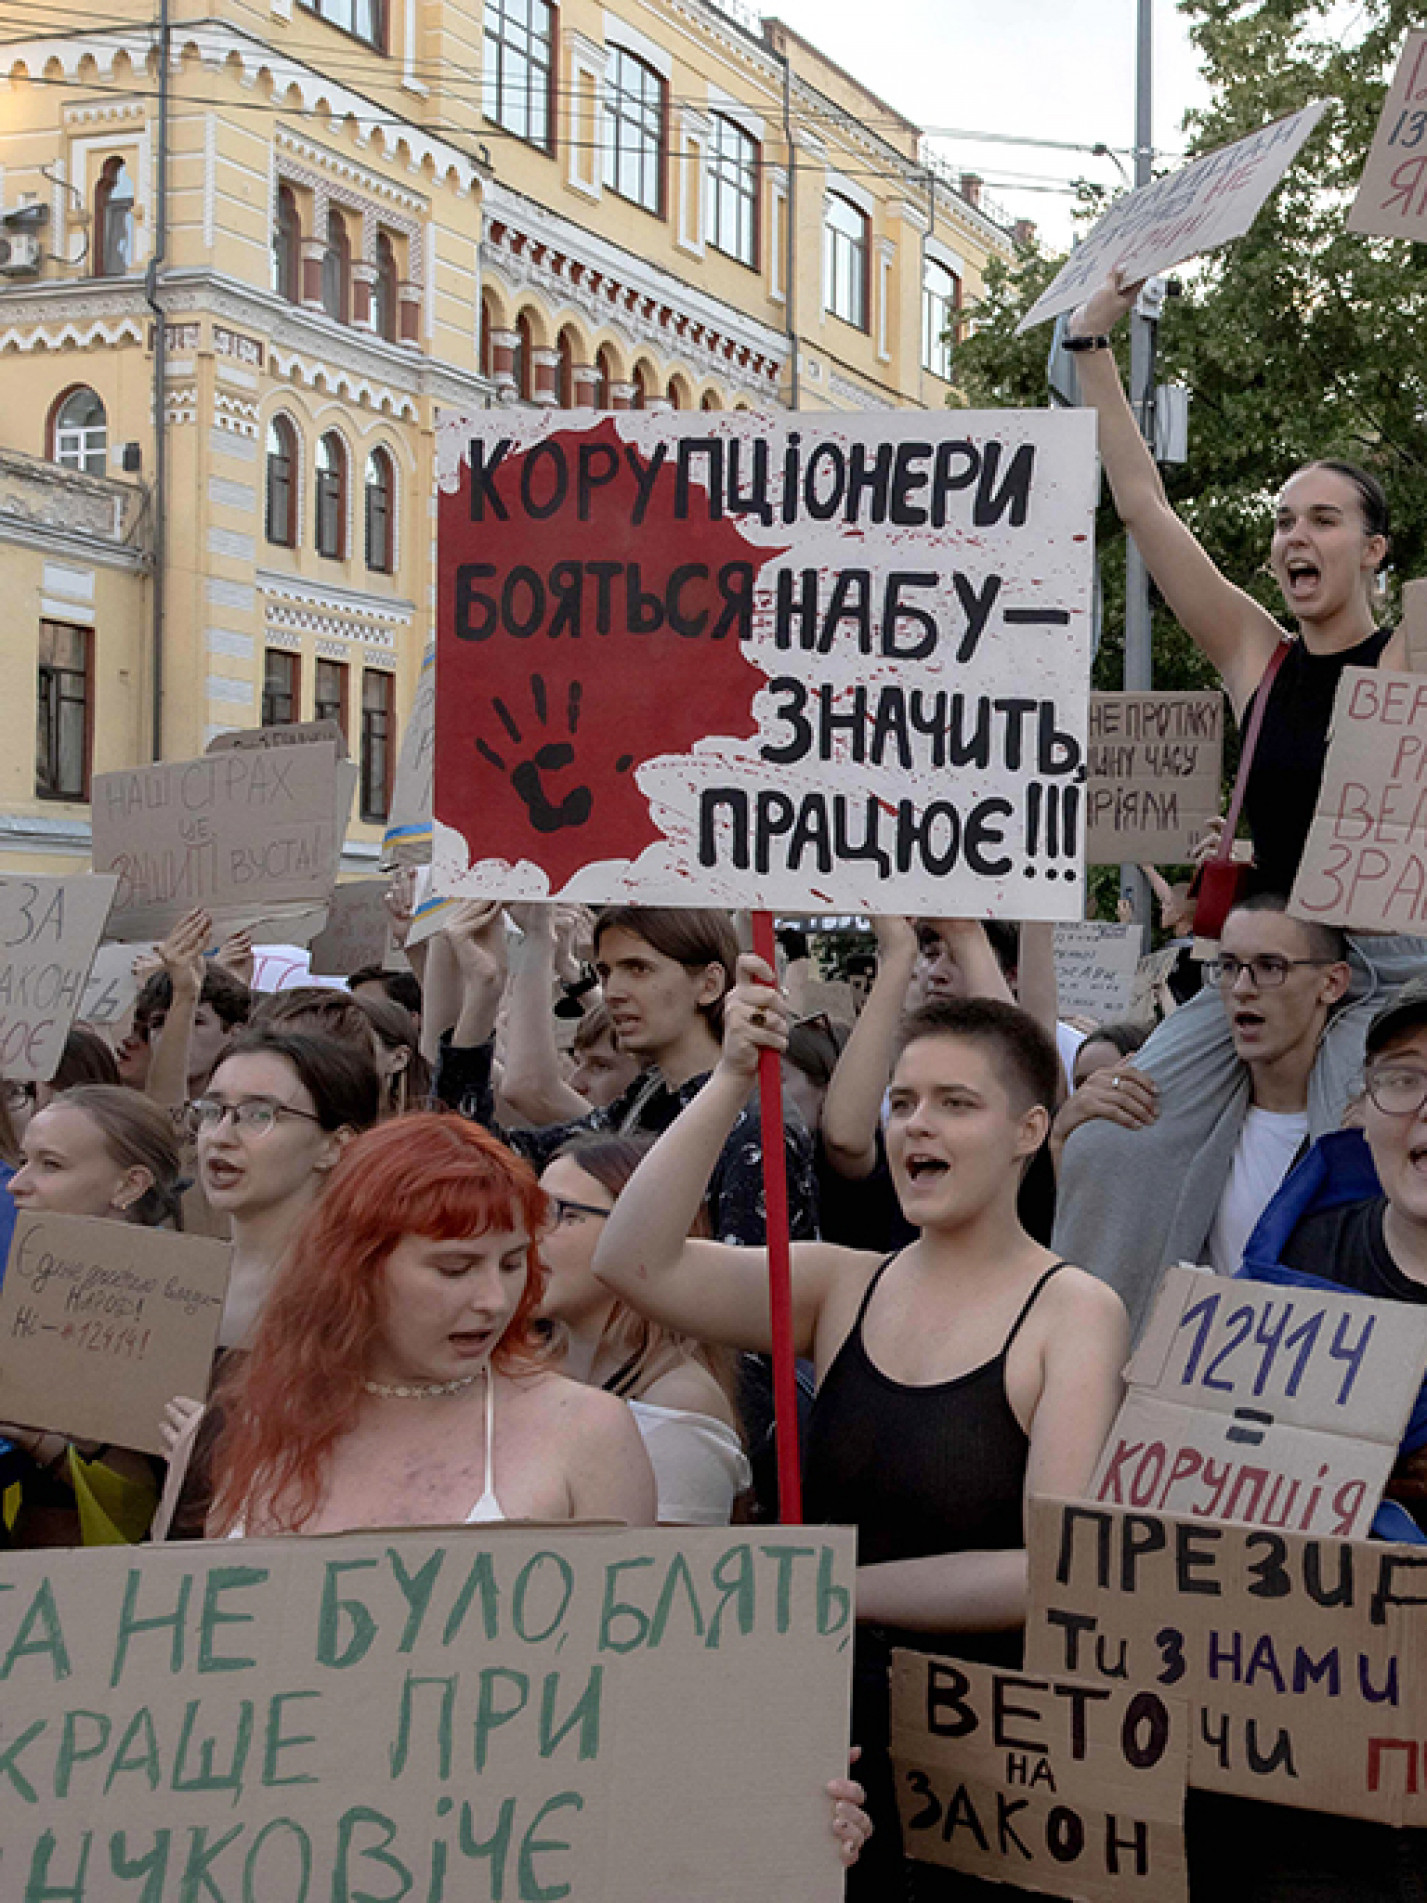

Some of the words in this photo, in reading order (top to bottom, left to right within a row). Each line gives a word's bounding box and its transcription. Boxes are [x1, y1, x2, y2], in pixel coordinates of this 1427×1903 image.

[454, 559, 754, 641] БОЯТЬСЯ
[181, 754, 294, 811] СТРАХ
[1179, 1290, 1378, 1406] 12414
[1096, 1437, 1370, 1538] КОРУПЦІЯ
[110, 1566, 271, 1689] НЕ
[1208, 1628, 1403, 1710] НАМИ
[390, 1664, 605, 1782] ПРИ
[926, 1660, 1171, 1771] ВЕТО
[904, 1768, 1152, 1878] ЗАКОН
[1005, 1751, 1058, 1793] НА
